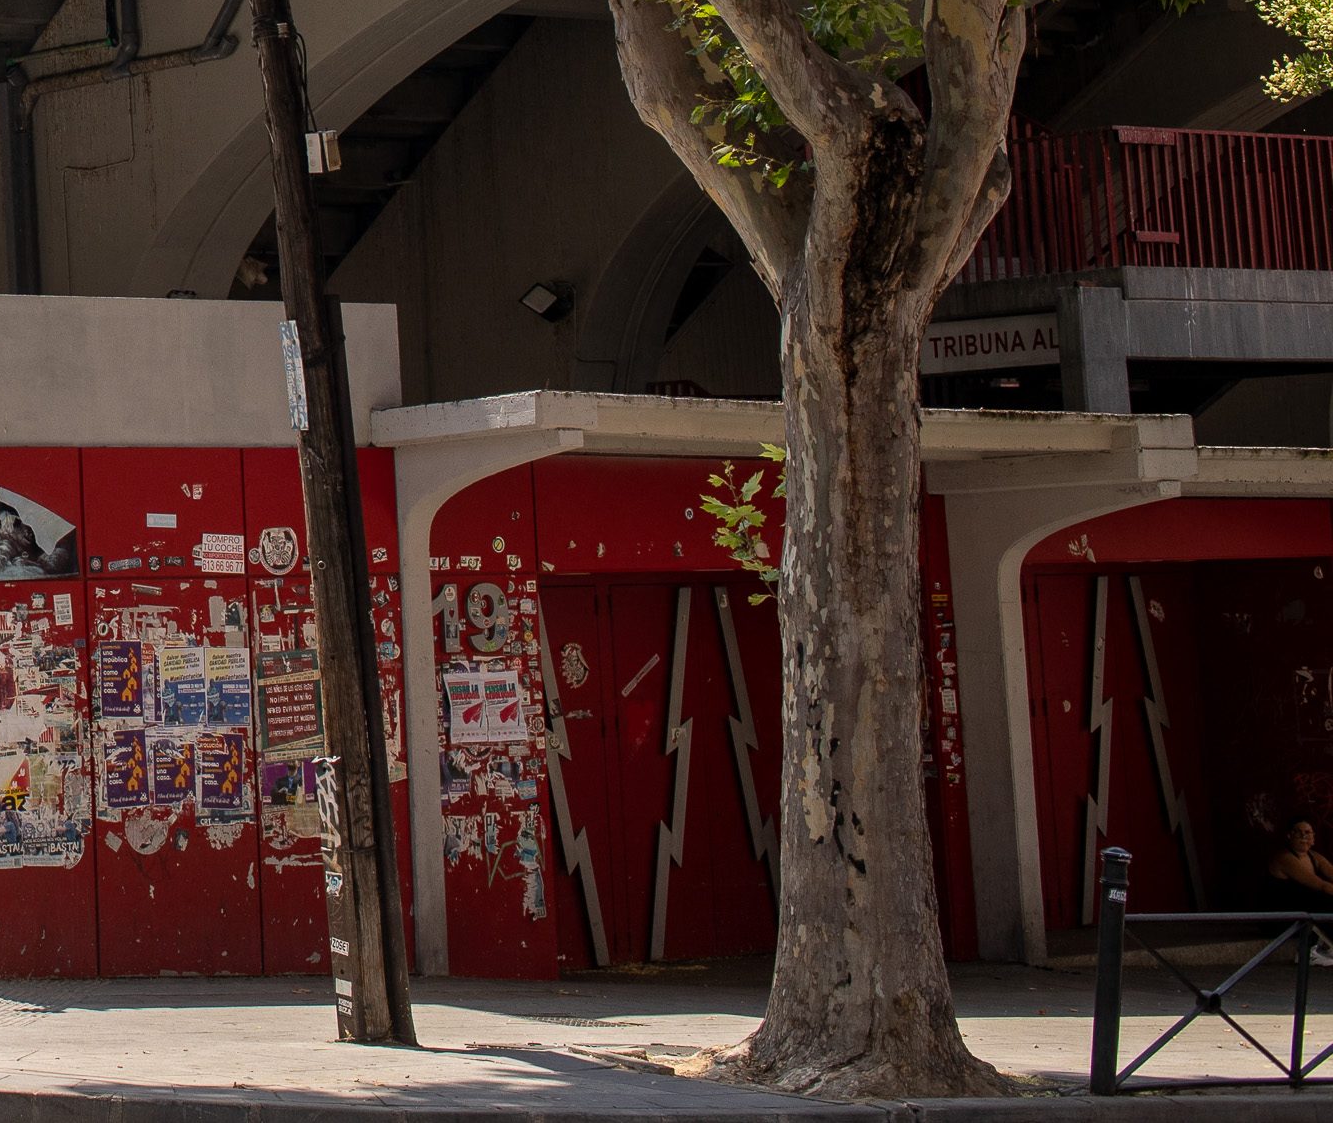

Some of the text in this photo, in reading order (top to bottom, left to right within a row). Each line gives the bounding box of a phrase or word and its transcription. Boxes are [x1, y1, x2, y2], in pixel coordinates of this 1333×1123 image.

[929, 330, 1025, 358] TRIBUNA
[206, 535, 240, 544] COMPRO
[203, 543, 243, 552] TU COCHE
[203, 560, 243, 572] 613 66 96 77
[433, 583, 508, 653] 19
[102, 656, 128, 664] república
